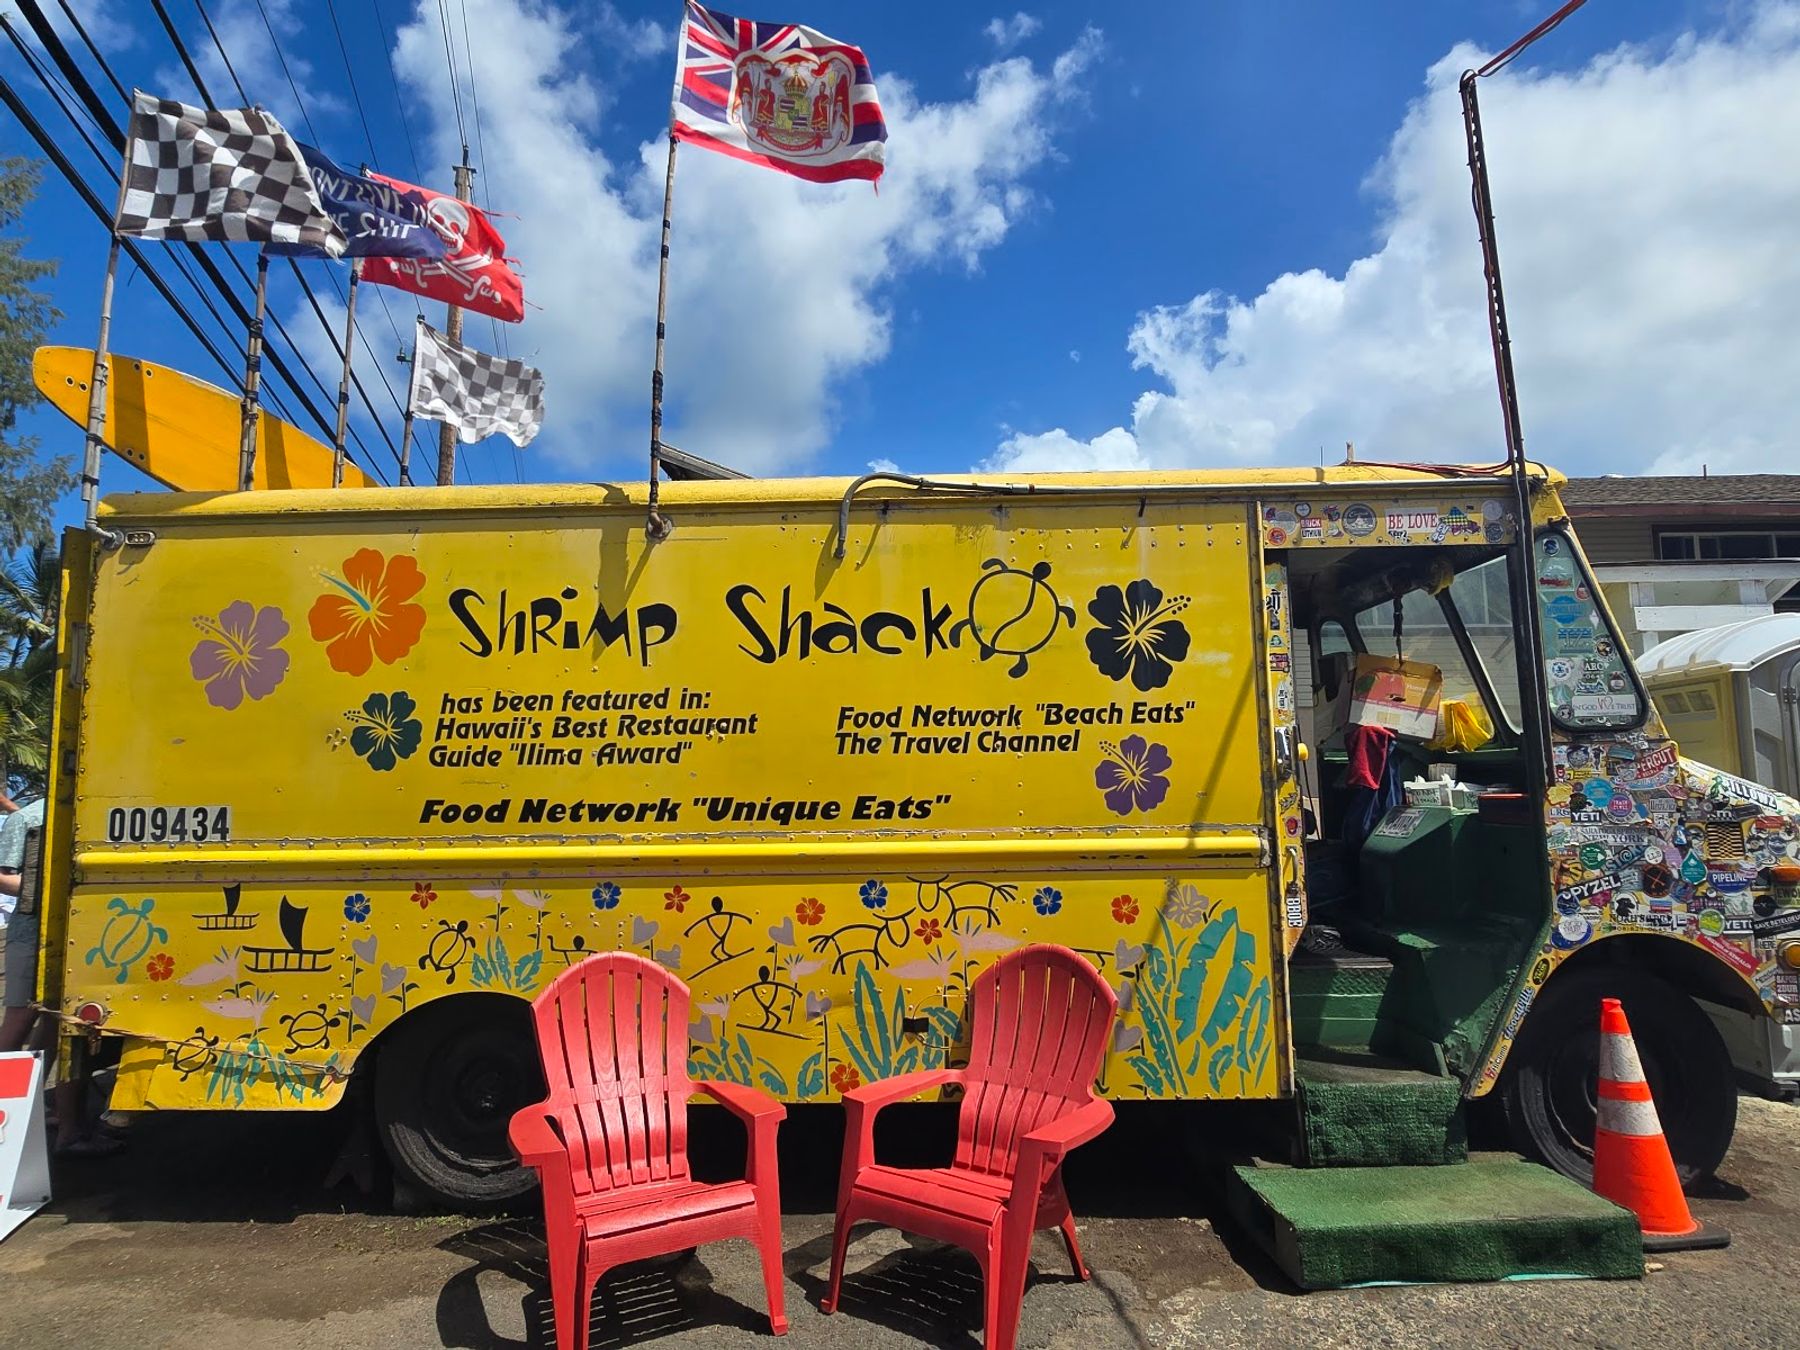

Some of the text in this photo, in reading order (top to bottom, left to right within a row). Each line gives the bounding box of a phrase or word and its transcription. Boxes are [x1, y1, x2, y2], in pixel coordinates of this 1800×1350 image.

[1389, 513, 1405, 529] BE
[1408, 512, 1438, 528] LOVE
[726, 585, 952, 664] Shack
[440, 688, 711, 715] has been featured in:
[434, 713, 758, 742] Hawaii's Best Restaurant
[837, 701, 1195, 731] Food Network "Beach Eats"
[428, 744, 503, 767] Guide
[597, 741, 693, 767] Award"
[835, 730, 1080, 755] The Travel Channel
[419, 794, 951, 826] Food Network "Unique Eats"
[1571, 812, 1600, 821] YETI
[108, 806, 230, 843] 009434
[1587, 834, 1645, 843] NEW YORK
[1569, 875, 1622, 898] PYZEL
[1725, 920, 1752, 929] YETI
